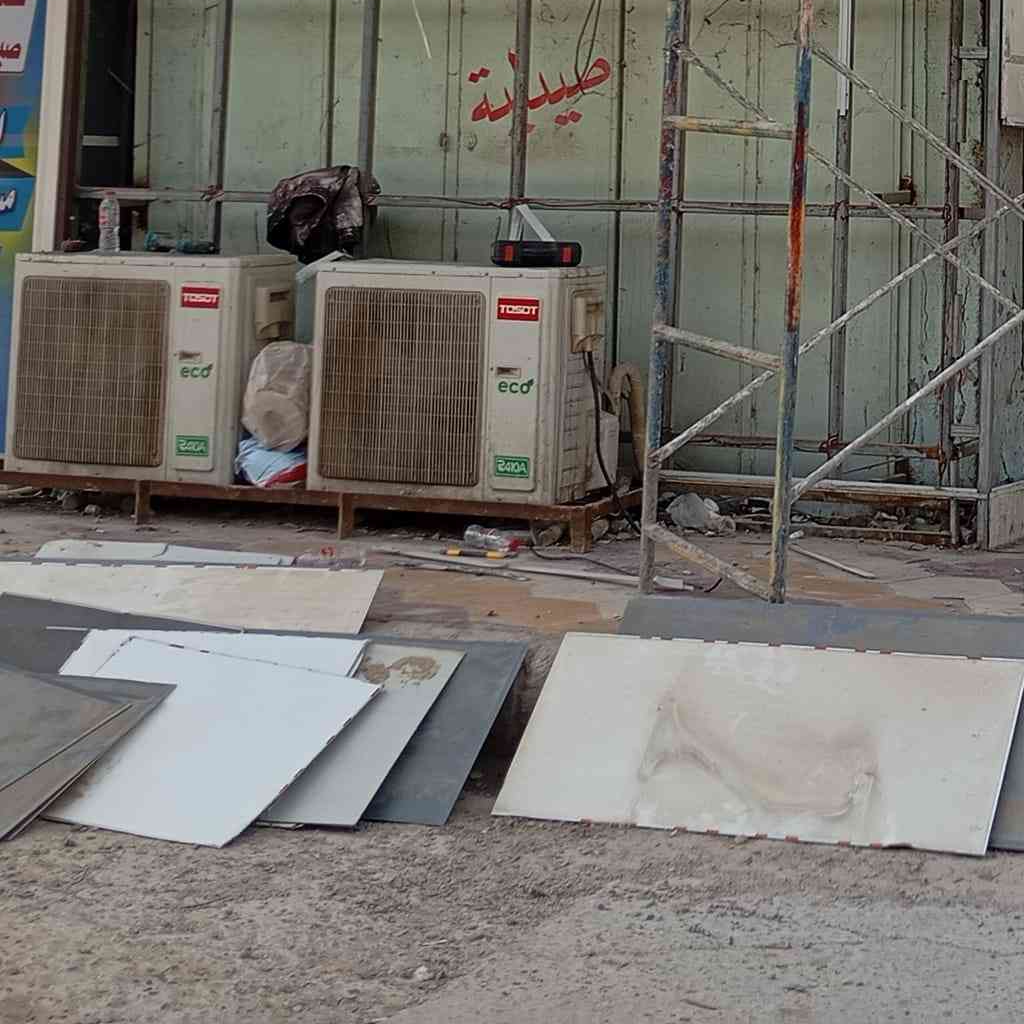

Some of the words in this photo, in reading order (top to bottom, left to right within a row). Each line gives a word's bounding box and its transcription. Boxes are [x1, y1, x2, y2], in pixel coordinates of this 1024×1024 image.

[500, 304, 538, 315] TOSOT
[180, 365, 212, 378] eco
[498, 380, 533, 394] eco
